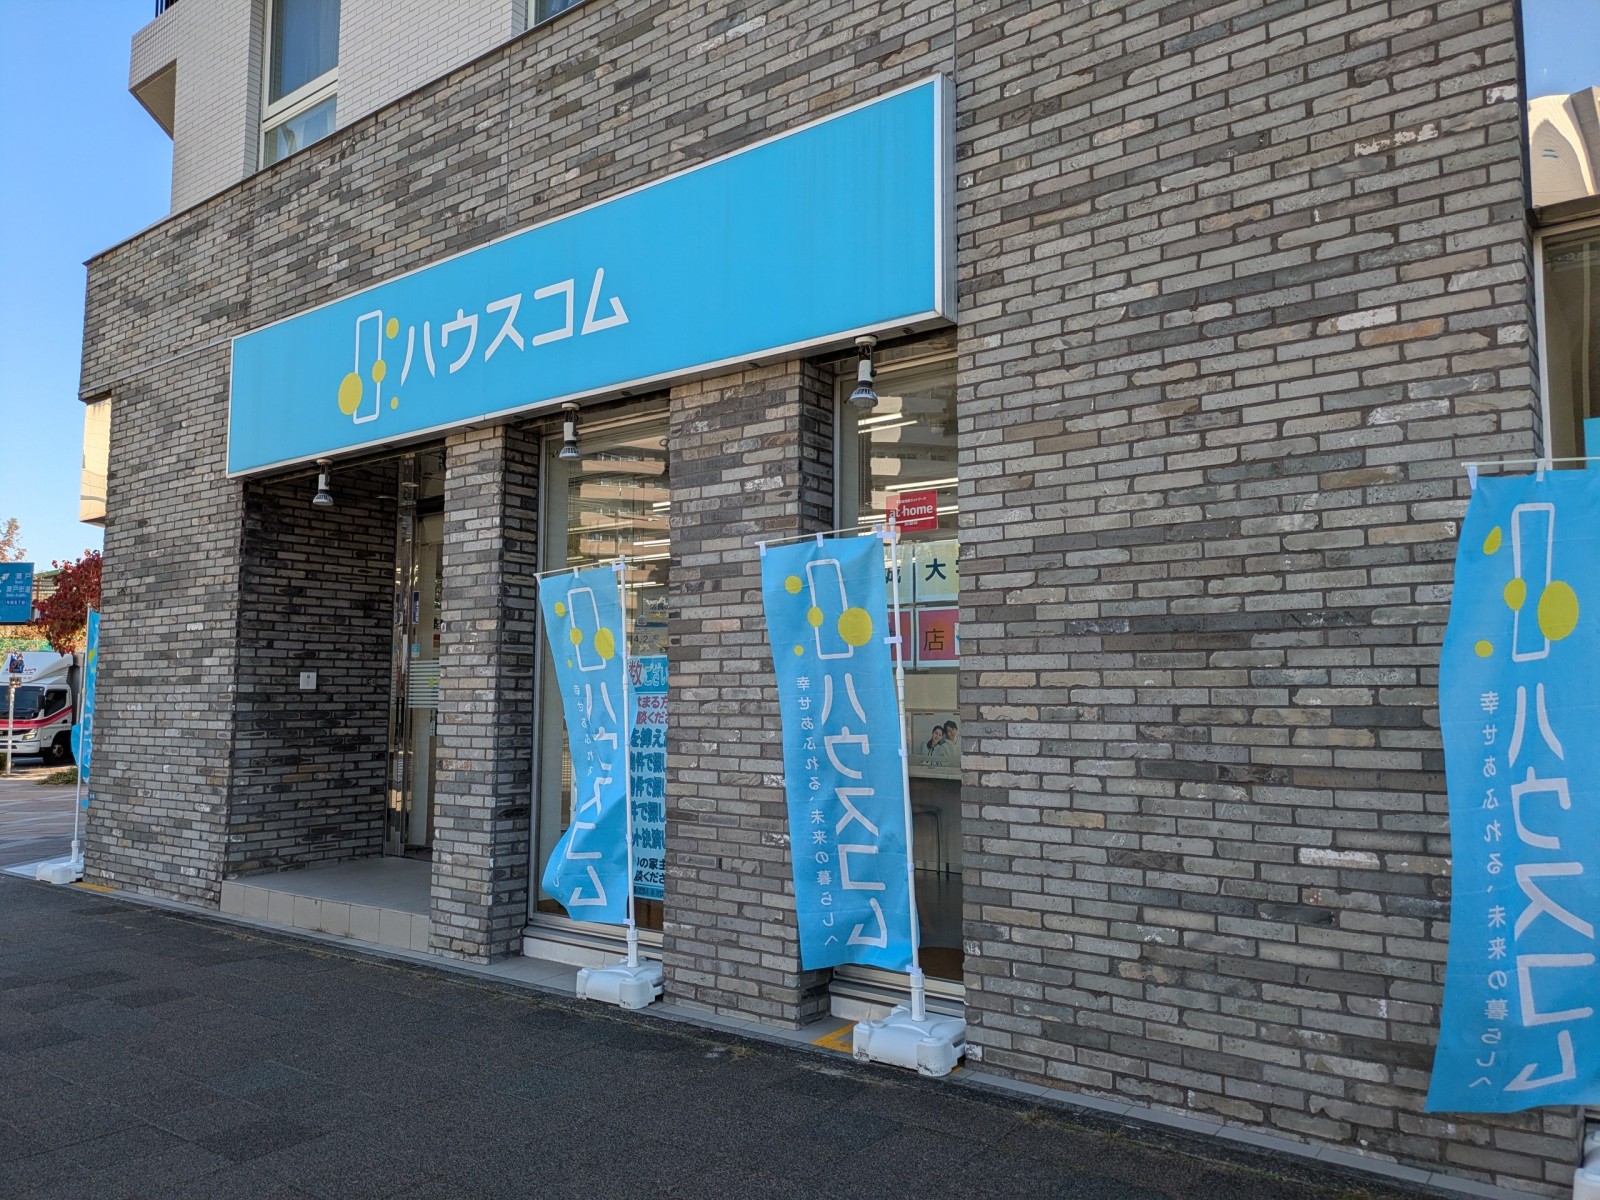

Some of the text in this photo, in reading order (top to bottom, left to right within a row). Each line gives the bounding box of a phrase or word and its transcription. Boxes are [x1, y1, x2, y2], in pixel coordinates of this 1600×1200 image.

[401, 267, 629, 387] ハウスコム
[902, 504, 933, 517] home
[924, 628, 944, 651] 店
